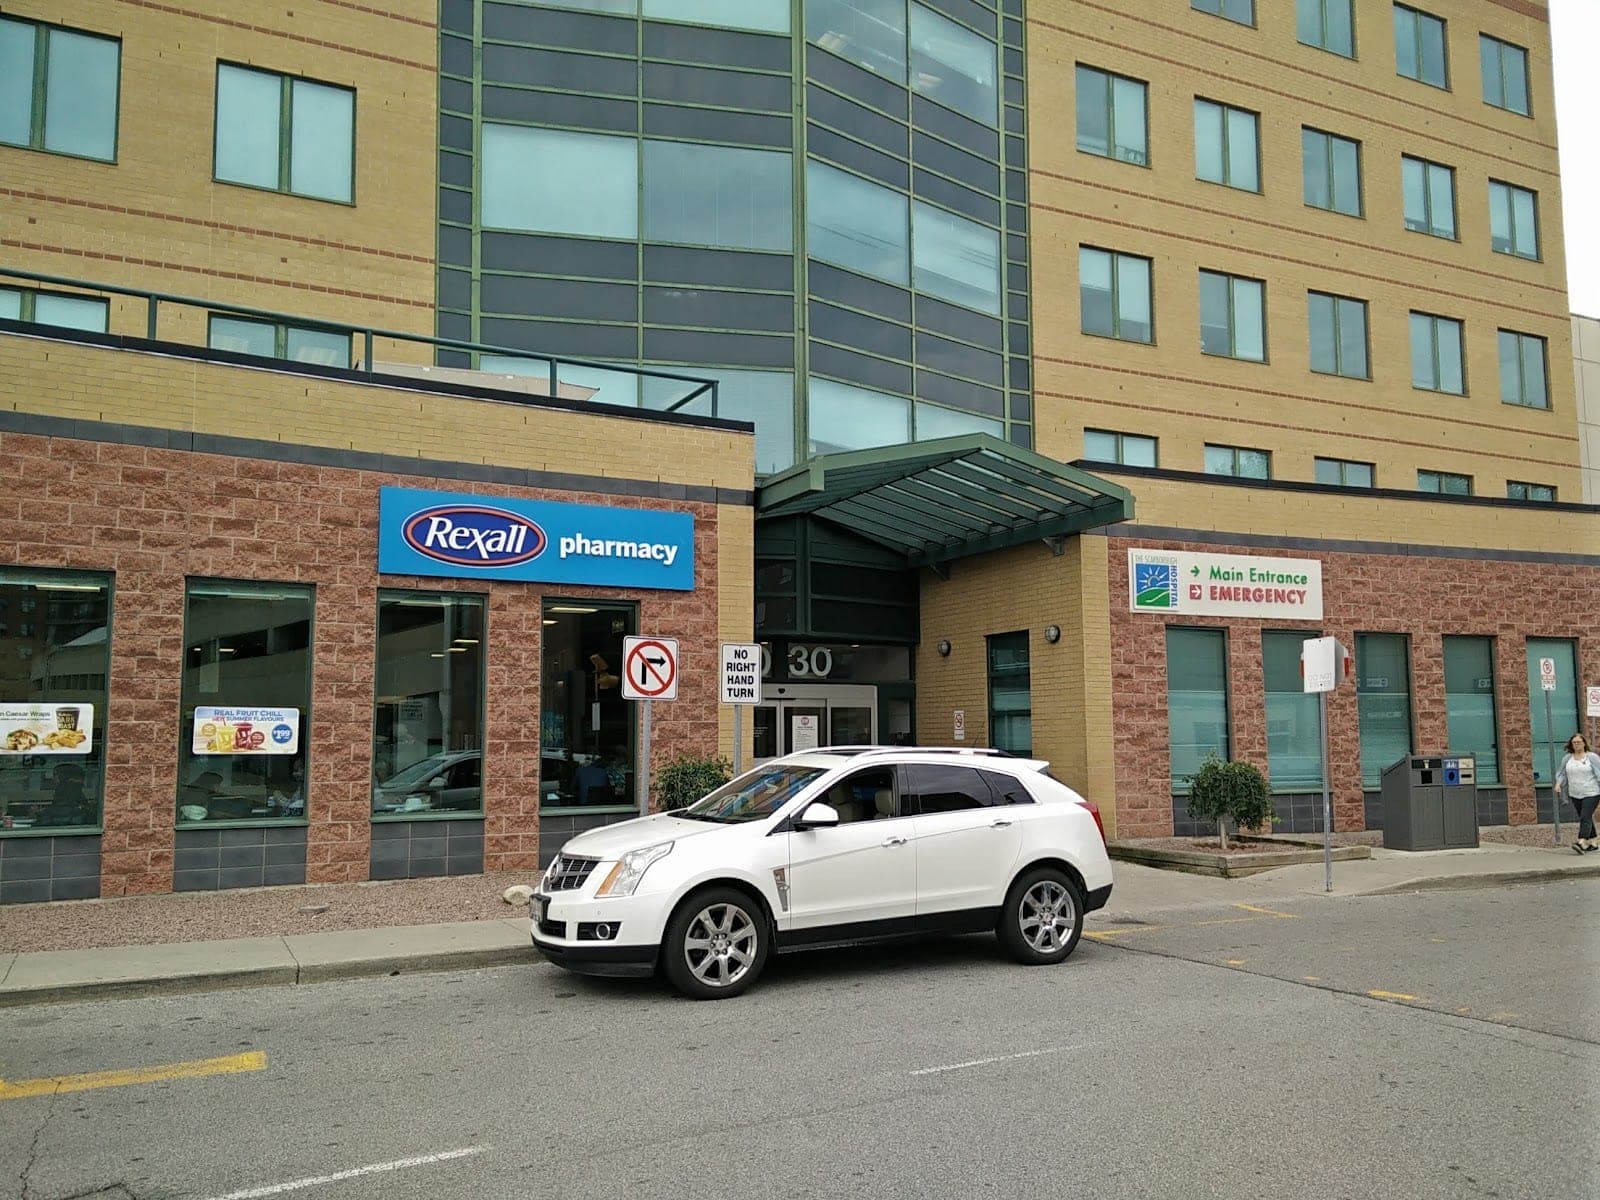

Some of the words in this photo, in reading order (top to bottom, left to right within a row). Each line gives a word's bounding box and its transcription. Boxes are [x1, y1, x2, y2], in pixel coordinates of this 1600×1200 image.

[424, 516, 528, 559] Rexall
[559, 533, 678, 565] pharmacy
[1209, 565, 1243, 582] Main
[1249, 567, 1308, 585] Entrance
[1171, 565, 1179, 608] HOSPITAL
[1209, 585, 1307, 604] EMERGENCY
[734, 649, 748, 660] NO
[726, 662, 757, 673] RIGHT
[727, 675, 754, 685] HAND
[727, 688, 754, 698] TURN
[30, 710, 51, 718] Wraps
